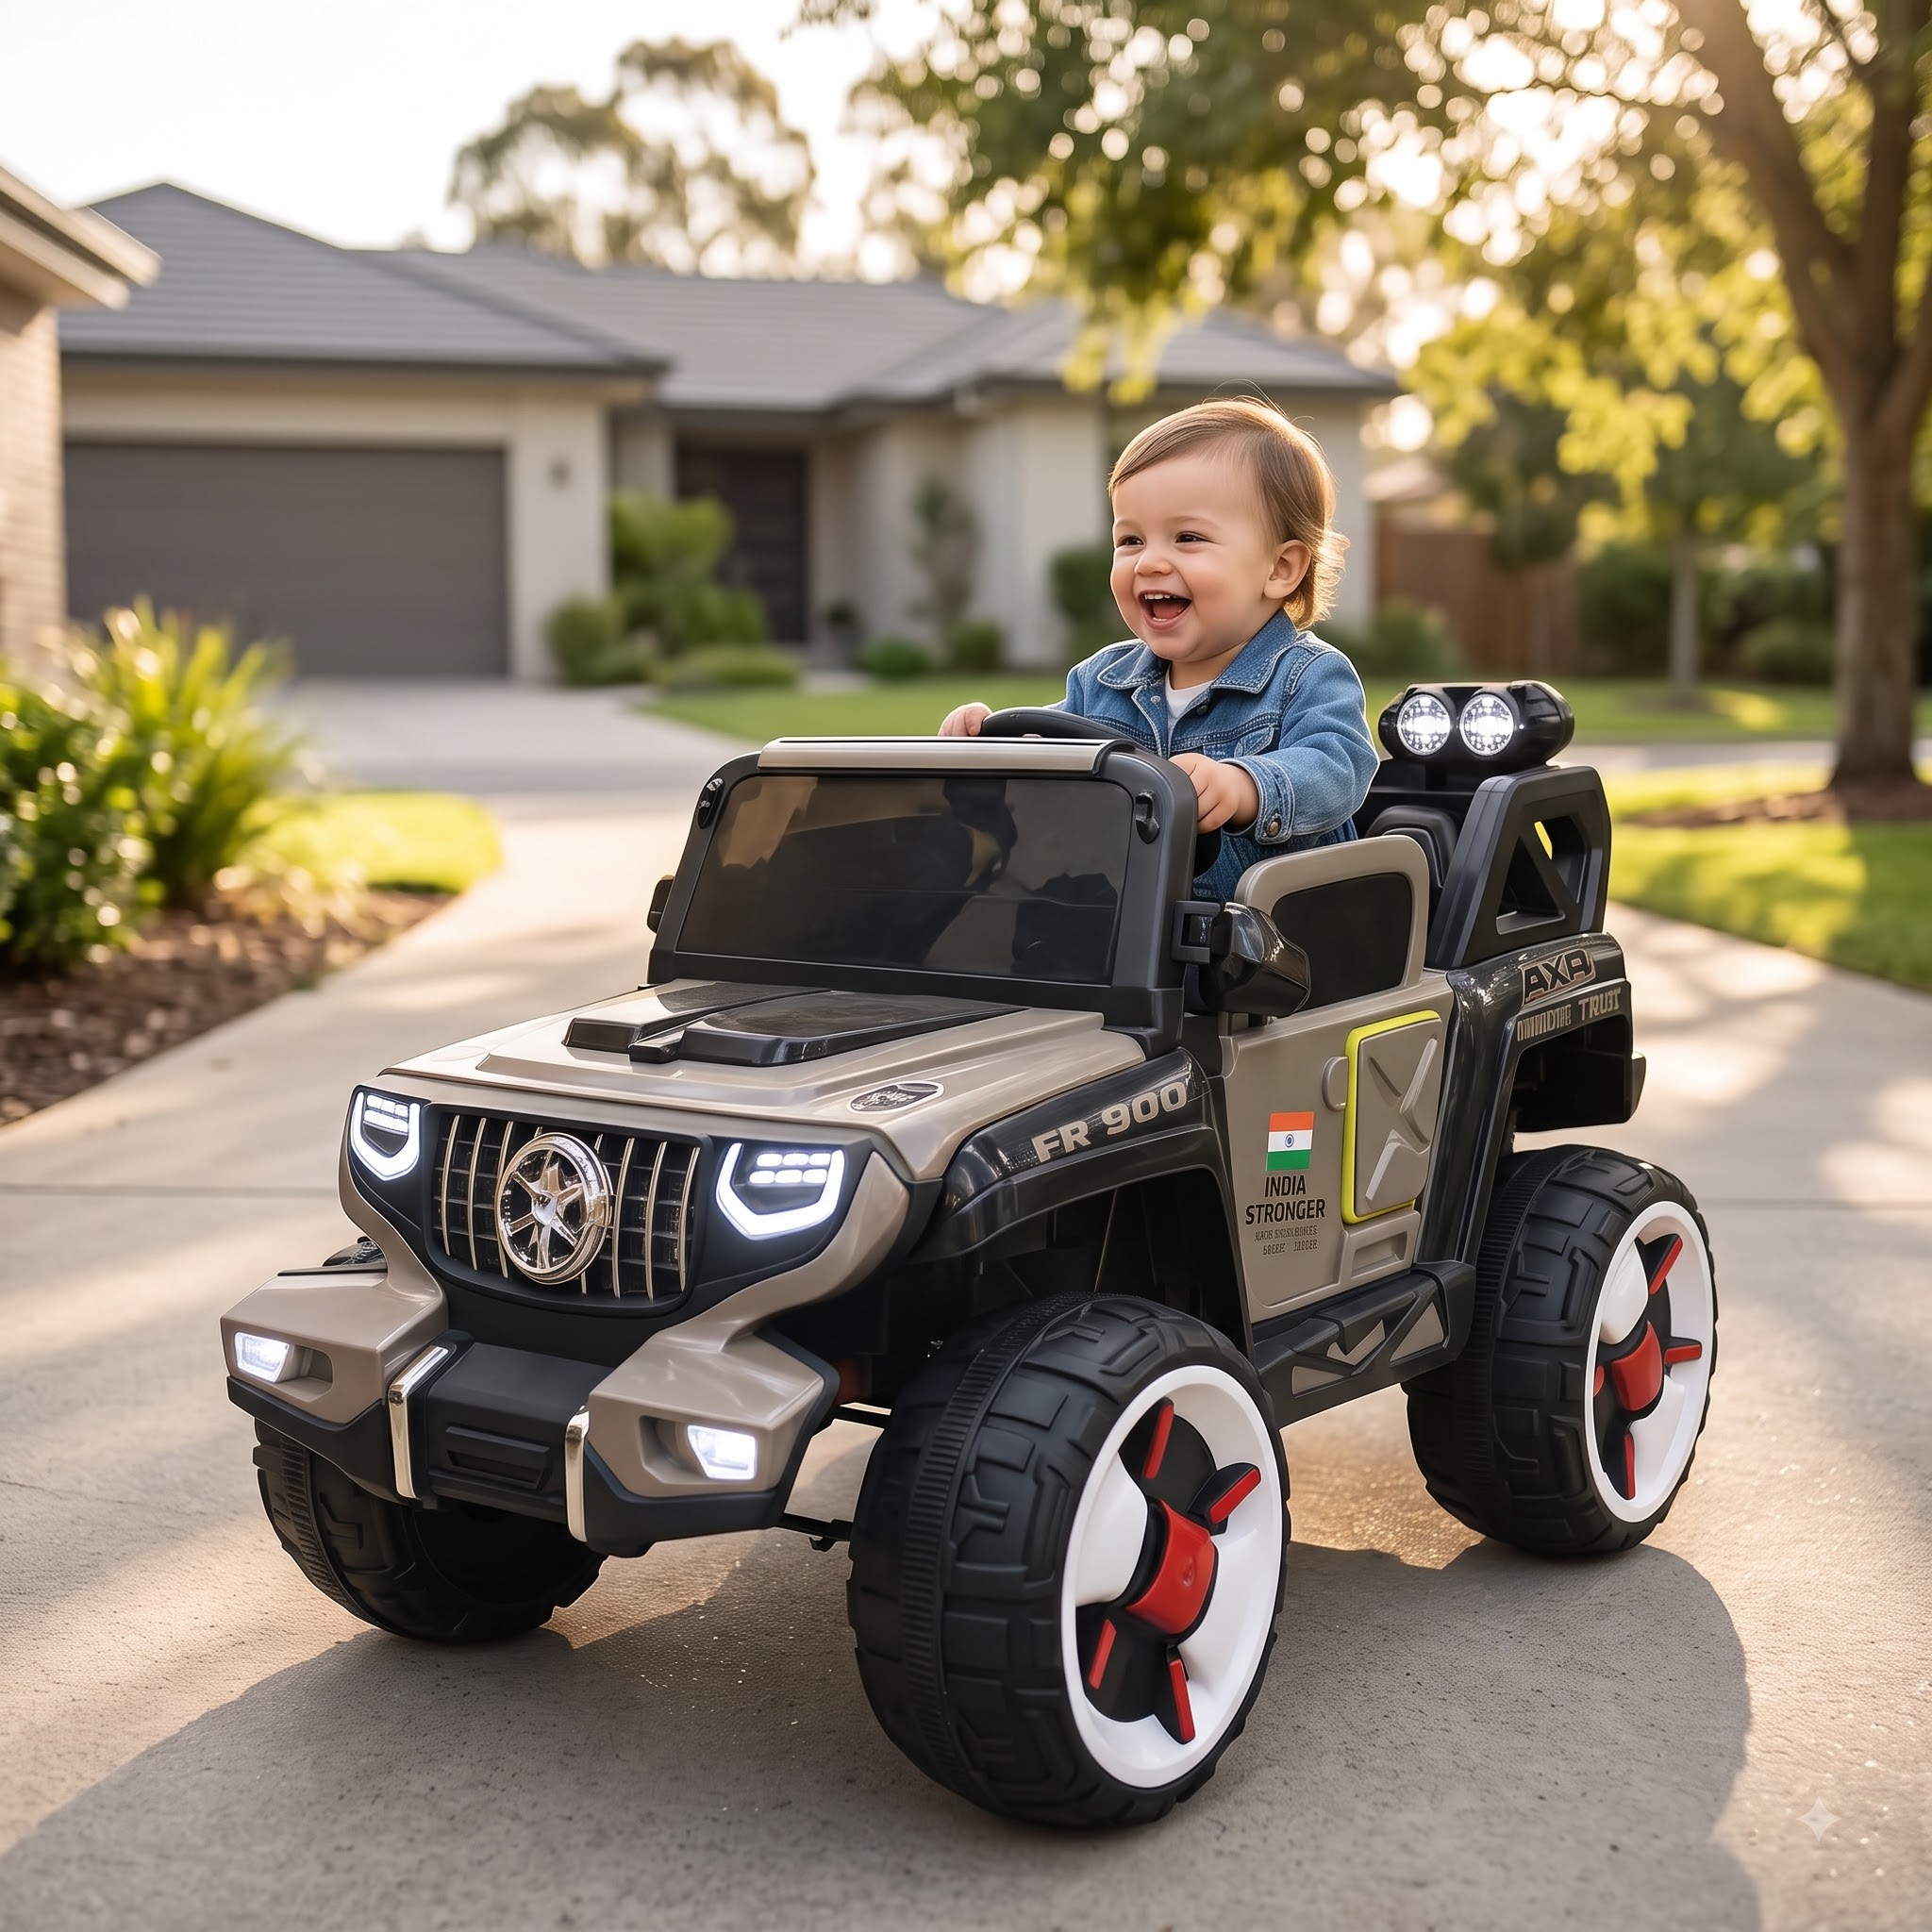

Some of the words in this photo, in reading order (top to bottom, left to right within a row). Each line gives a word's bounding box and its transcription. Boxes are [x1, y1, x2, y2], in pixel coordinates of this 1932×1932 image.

[1030, 1120, 1091, 1163] FR
[1101, 1081, 1188, 1136] 900
[1264, 1174, 1307, 1198] INDIA
[1245, 1198, 1325, 1225] STRONGER
